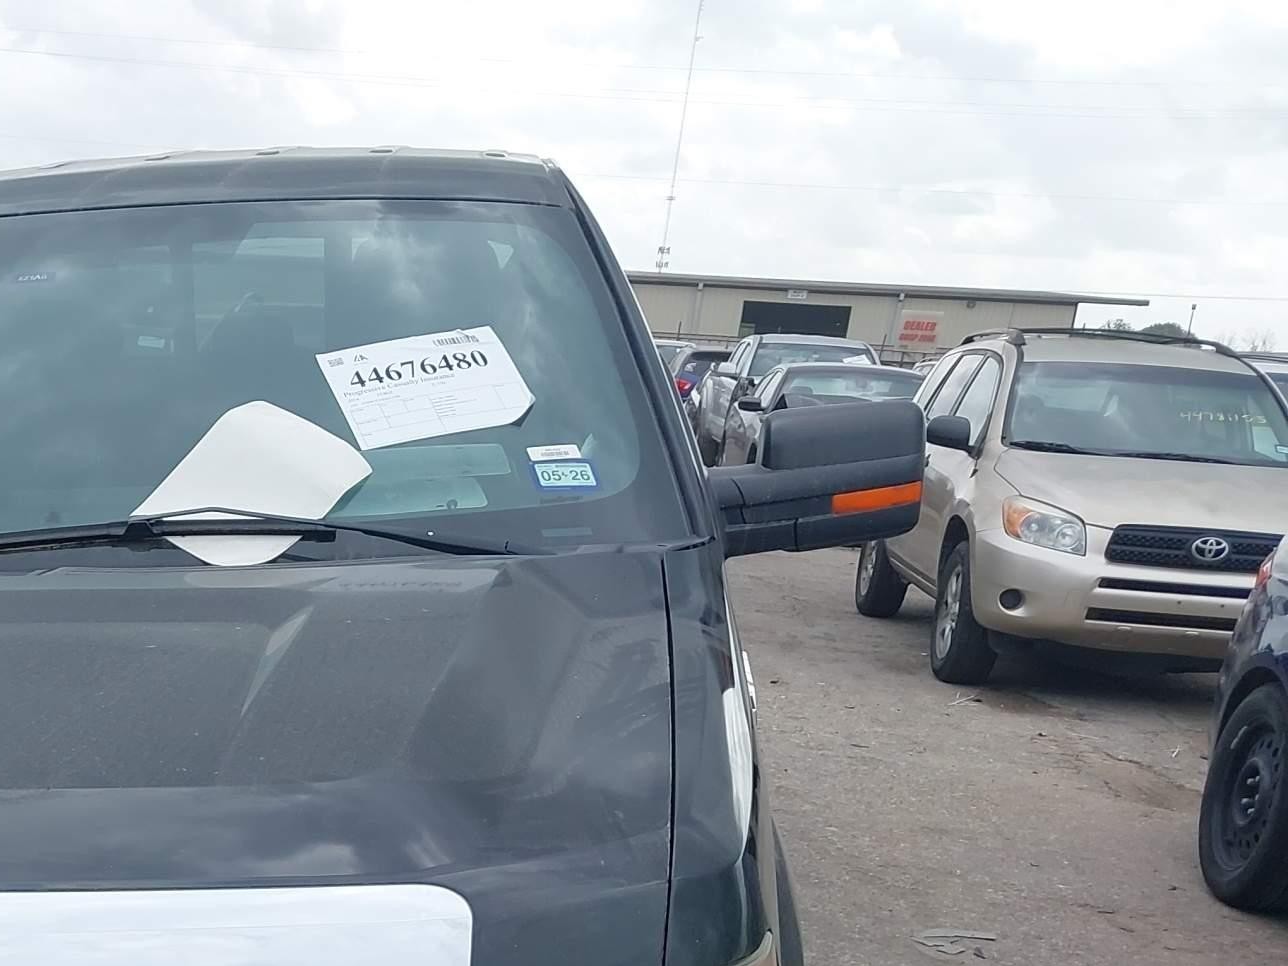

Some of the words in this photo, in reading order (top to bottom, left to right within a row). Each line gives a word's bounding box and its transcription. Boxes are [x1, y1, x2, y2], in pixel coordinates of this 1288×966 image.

[350, 350, 488, 388] 44676480
[541, 470, 562, 481] 05
[569, 470, 590, 481] 26
